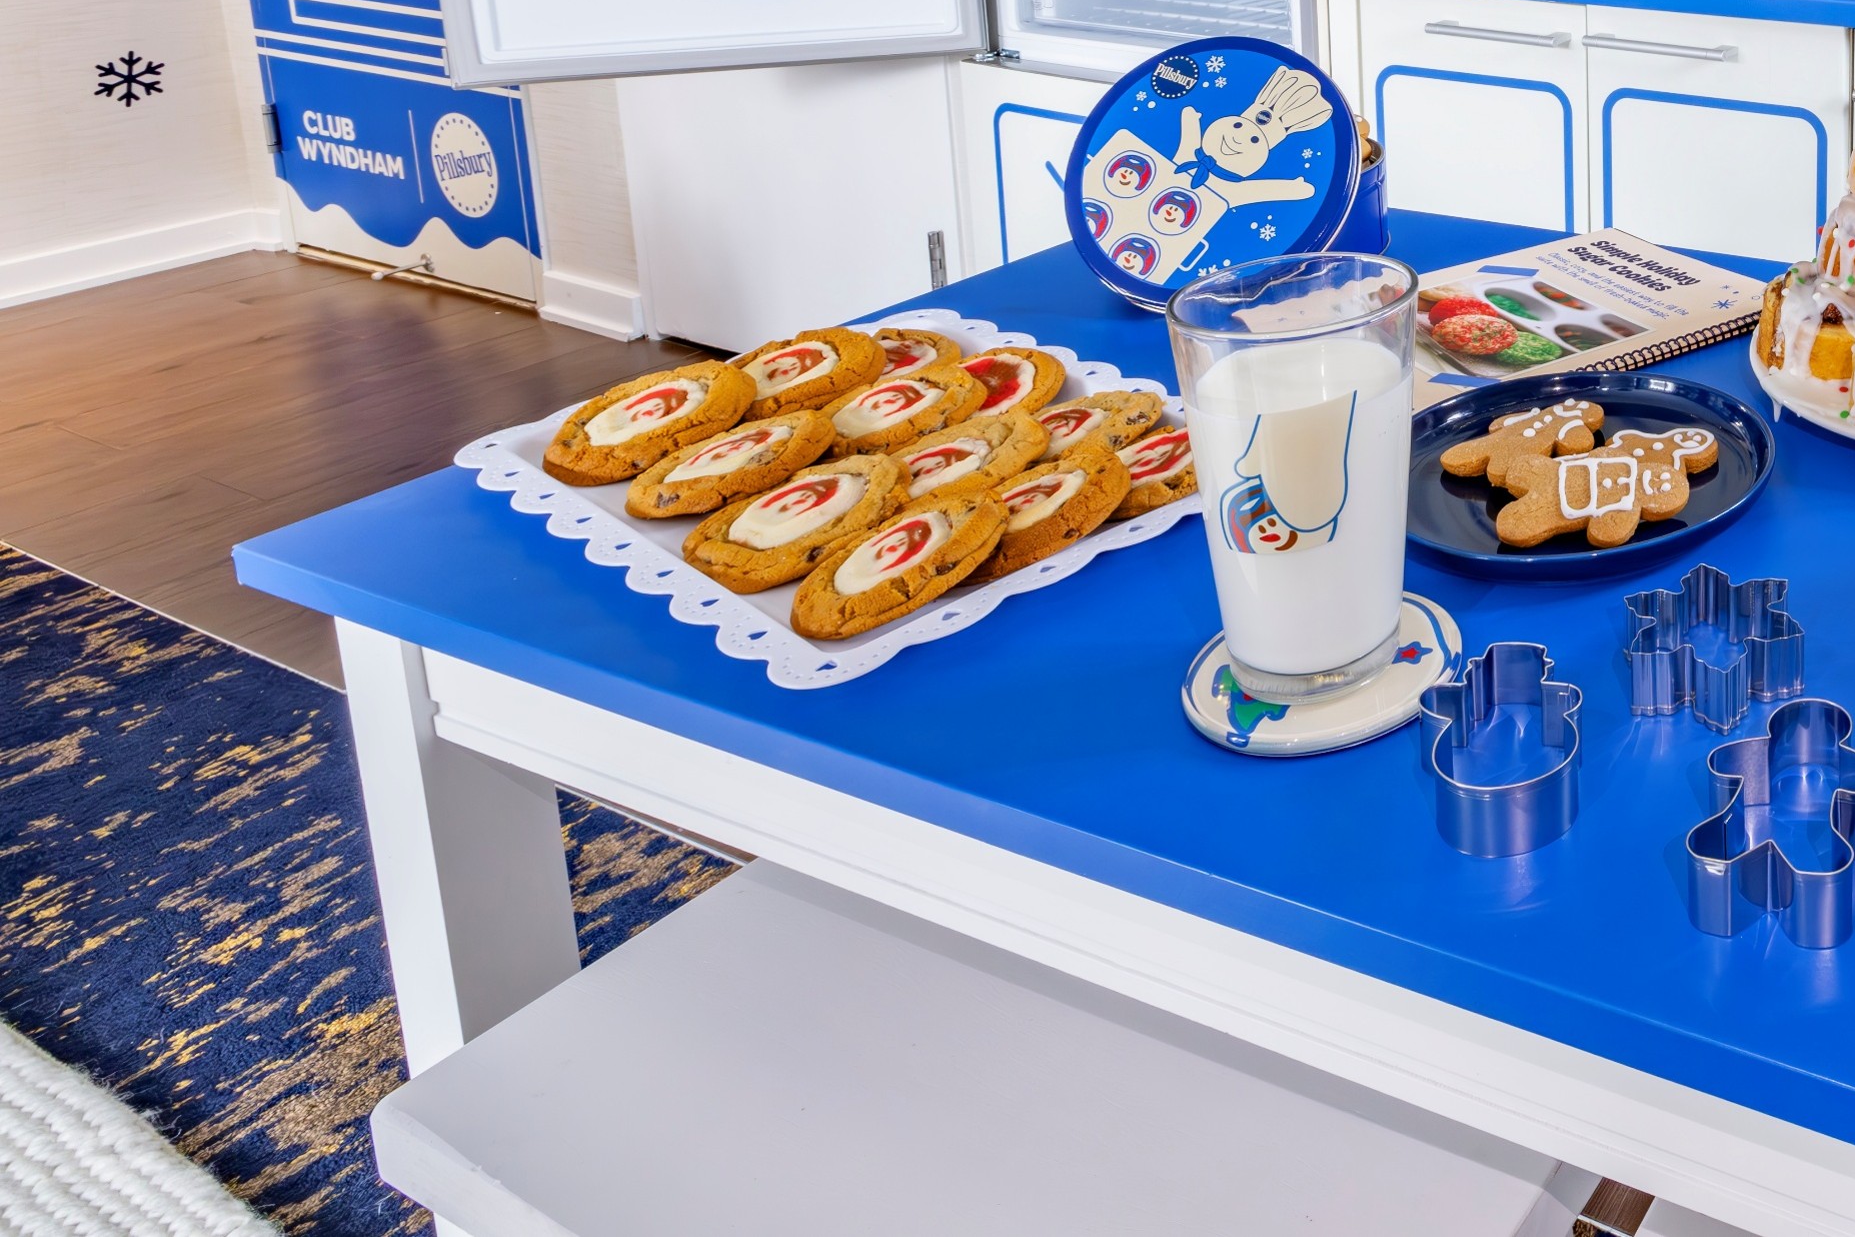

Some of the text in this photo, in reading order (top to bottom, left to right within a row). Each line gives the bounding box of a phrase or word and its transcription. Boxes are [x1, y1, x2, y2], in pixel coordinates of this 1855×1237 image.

[1153, 62, 1198, 90] Pillsbury
[302, 110, 357, 141] CLUB
[296, 136, 405, 180] WYNDHAM
[434, 149, 493, 182] Pillsbury
[1567, 246, 1672, 292] Sugar Cookies
[1590, 240, 1701, 286] Simple Holiday
